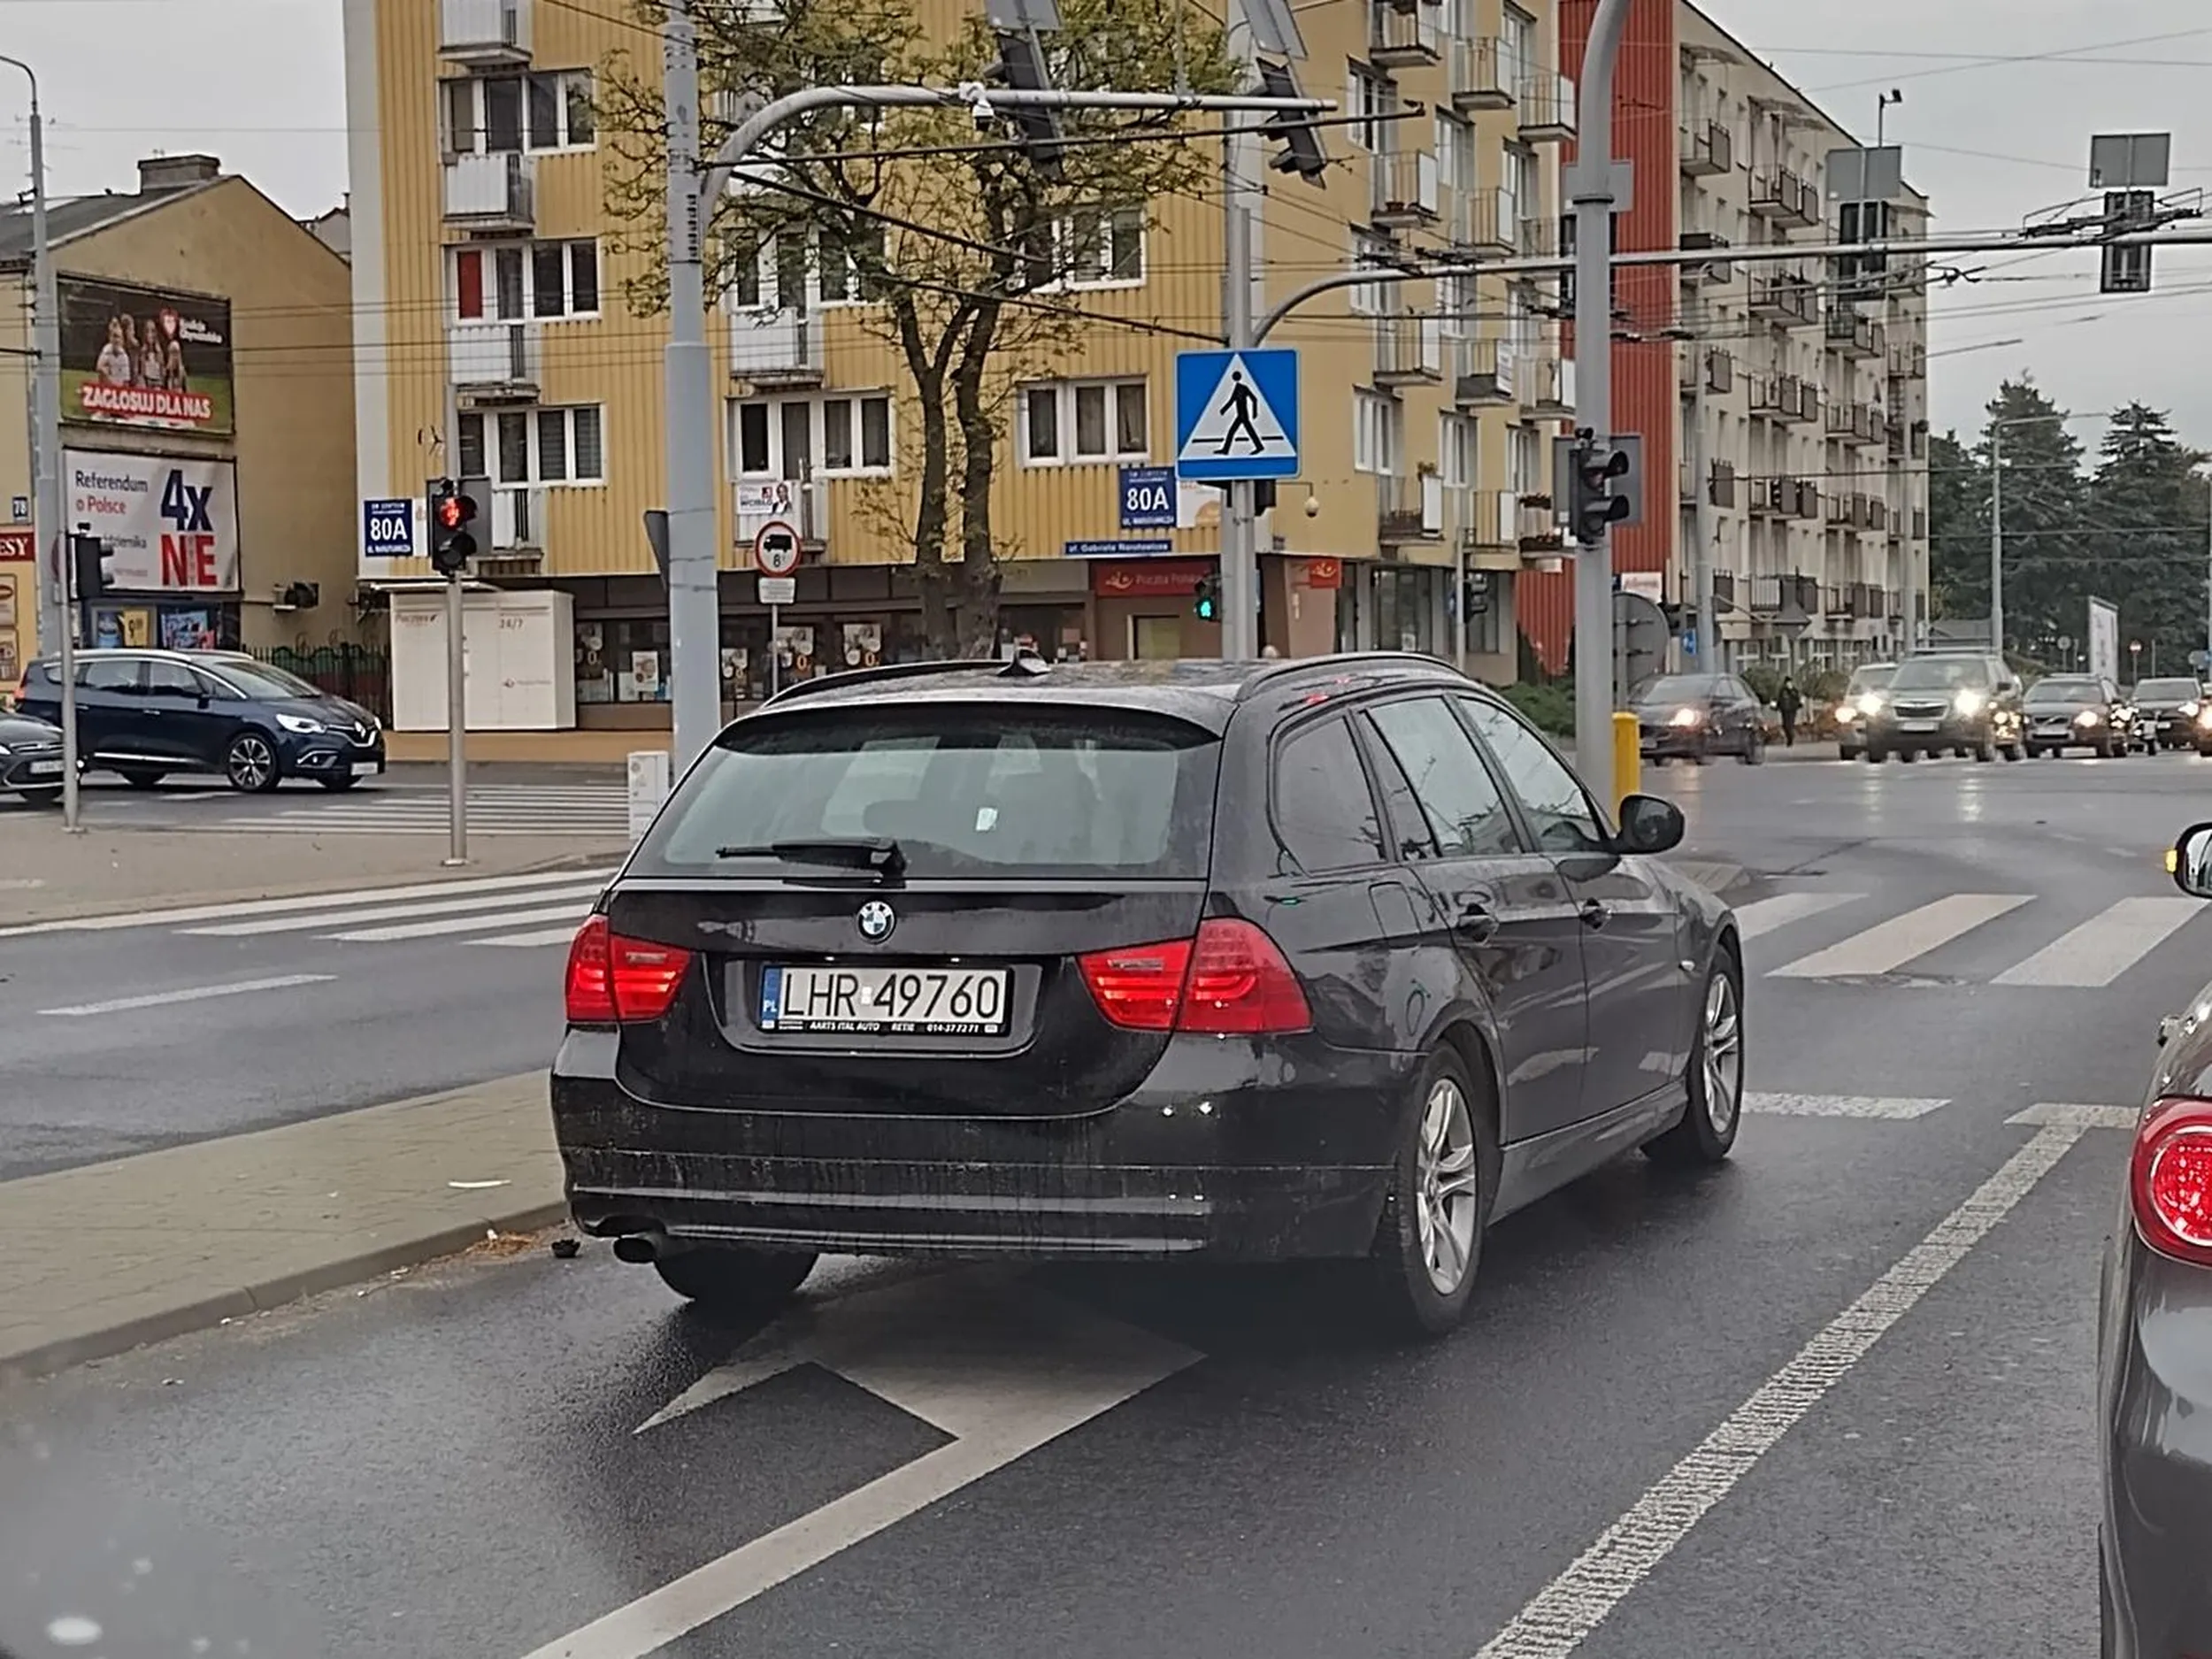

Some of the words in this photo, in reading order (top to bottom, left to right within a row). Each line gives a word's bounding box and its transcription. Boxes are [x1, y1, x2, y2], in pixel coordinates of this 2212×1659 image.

[156, 396, 181, 416] DLA
[183, 397, 211, 419] NAS
[75, 470, 148, 492] Referendum
[76, 498, 85, 511] o
[87, 495, 127, 514] Polsce
[161, 469, 213, 531] 4x
[1127, 486, 1170, 511] 80A
[370, 517, 408, 541] 80A
[763, 1001, 777, 1012] PL
[784, 973, 856, 1017] LHR
[872, 973, 1000, 1018] 49760
[809, 1020, 836, 1031] AARTS
[856, 1022, 881, 1032] AUTO
